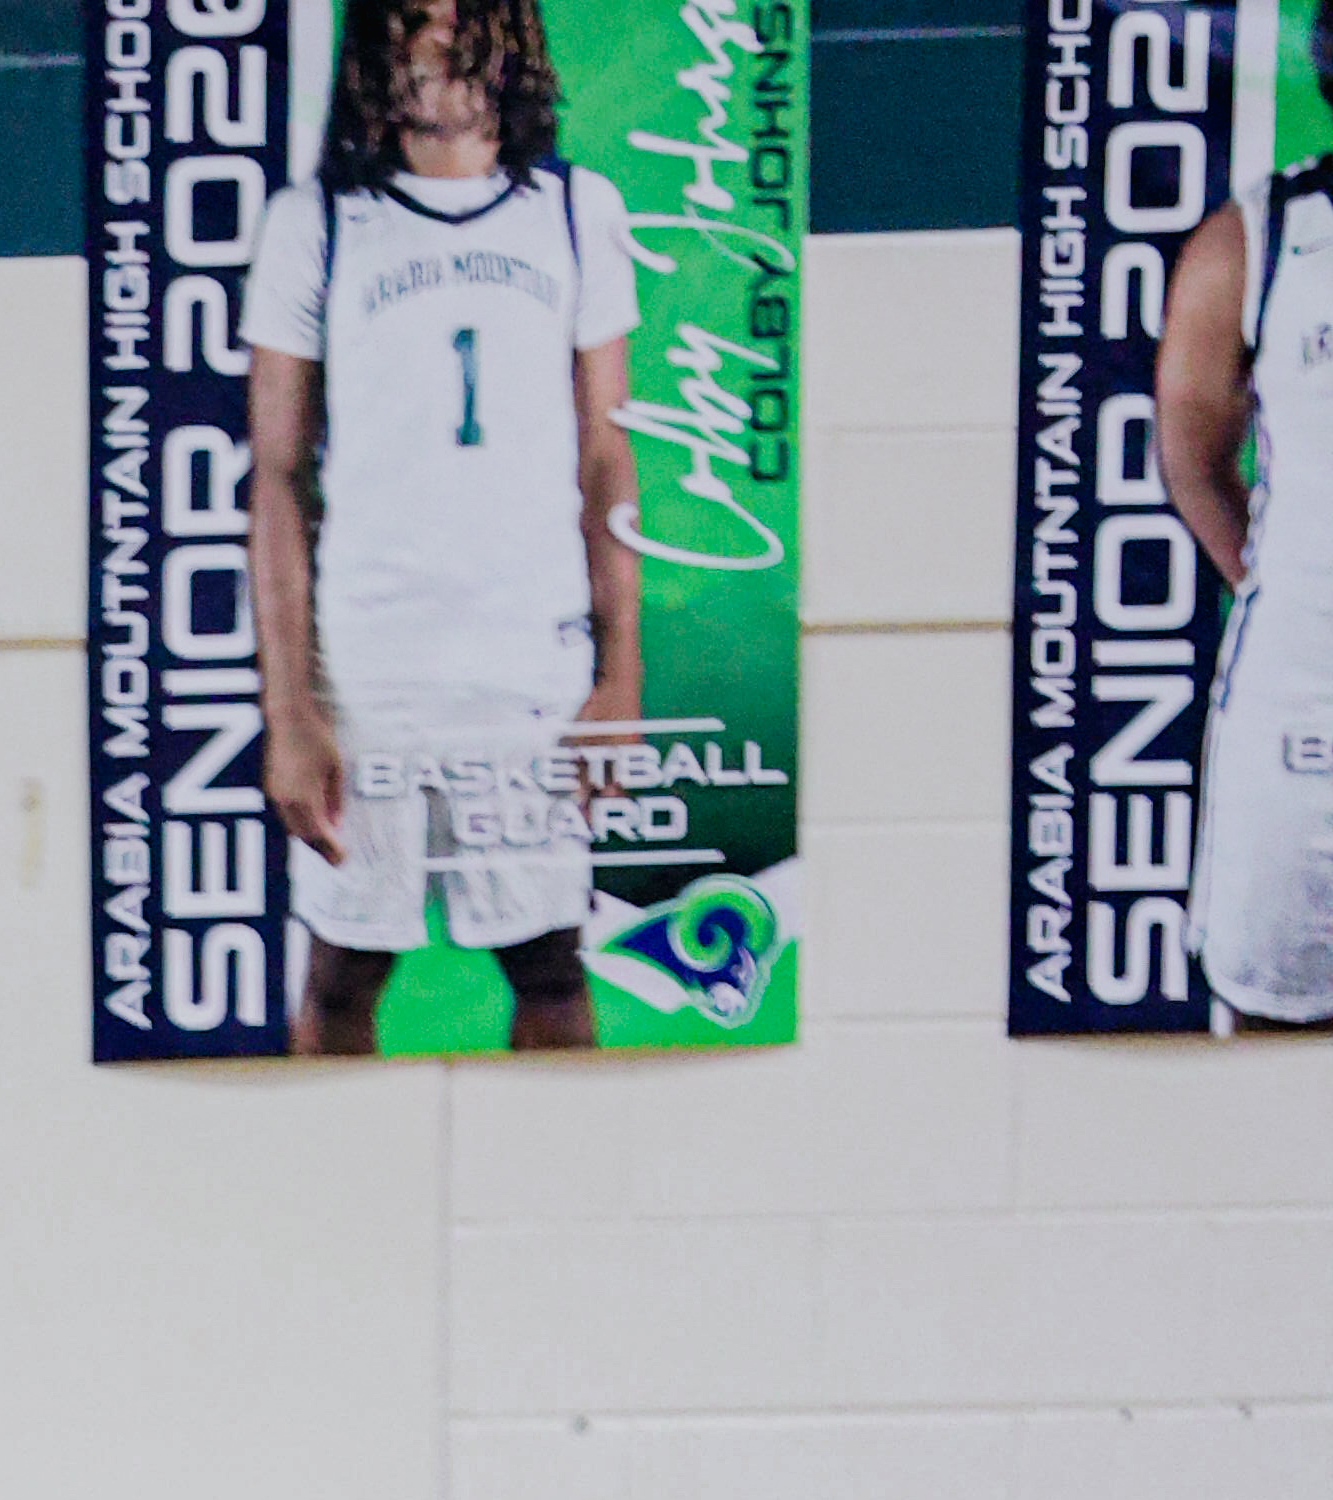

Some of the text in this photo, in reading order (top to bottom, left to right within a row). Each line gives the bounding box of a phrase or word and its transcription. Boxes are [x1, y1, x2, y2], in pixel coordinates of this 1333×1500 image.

[102, 220, 151, 372] HIGH
[749, 252, 791, 483] COLBY
[1036, 185, 1089, 338] HIGH
[449, 326, 485, 448] 1
[605, 322, 786, 572] Colby
[101, 386, 151, 759] MOUTNTAIN
[1028, 352, 1084, 729] MOUTNTAIN
[161, 423, 267, 1032] SENIOR
[357, 738, 790, 800] BASKETBALL
[455, 794, 691, 850] GUARD
[103, 771, 153, 1031] ARABIA
[1025, 742, 1076, 1004] ARABIA
